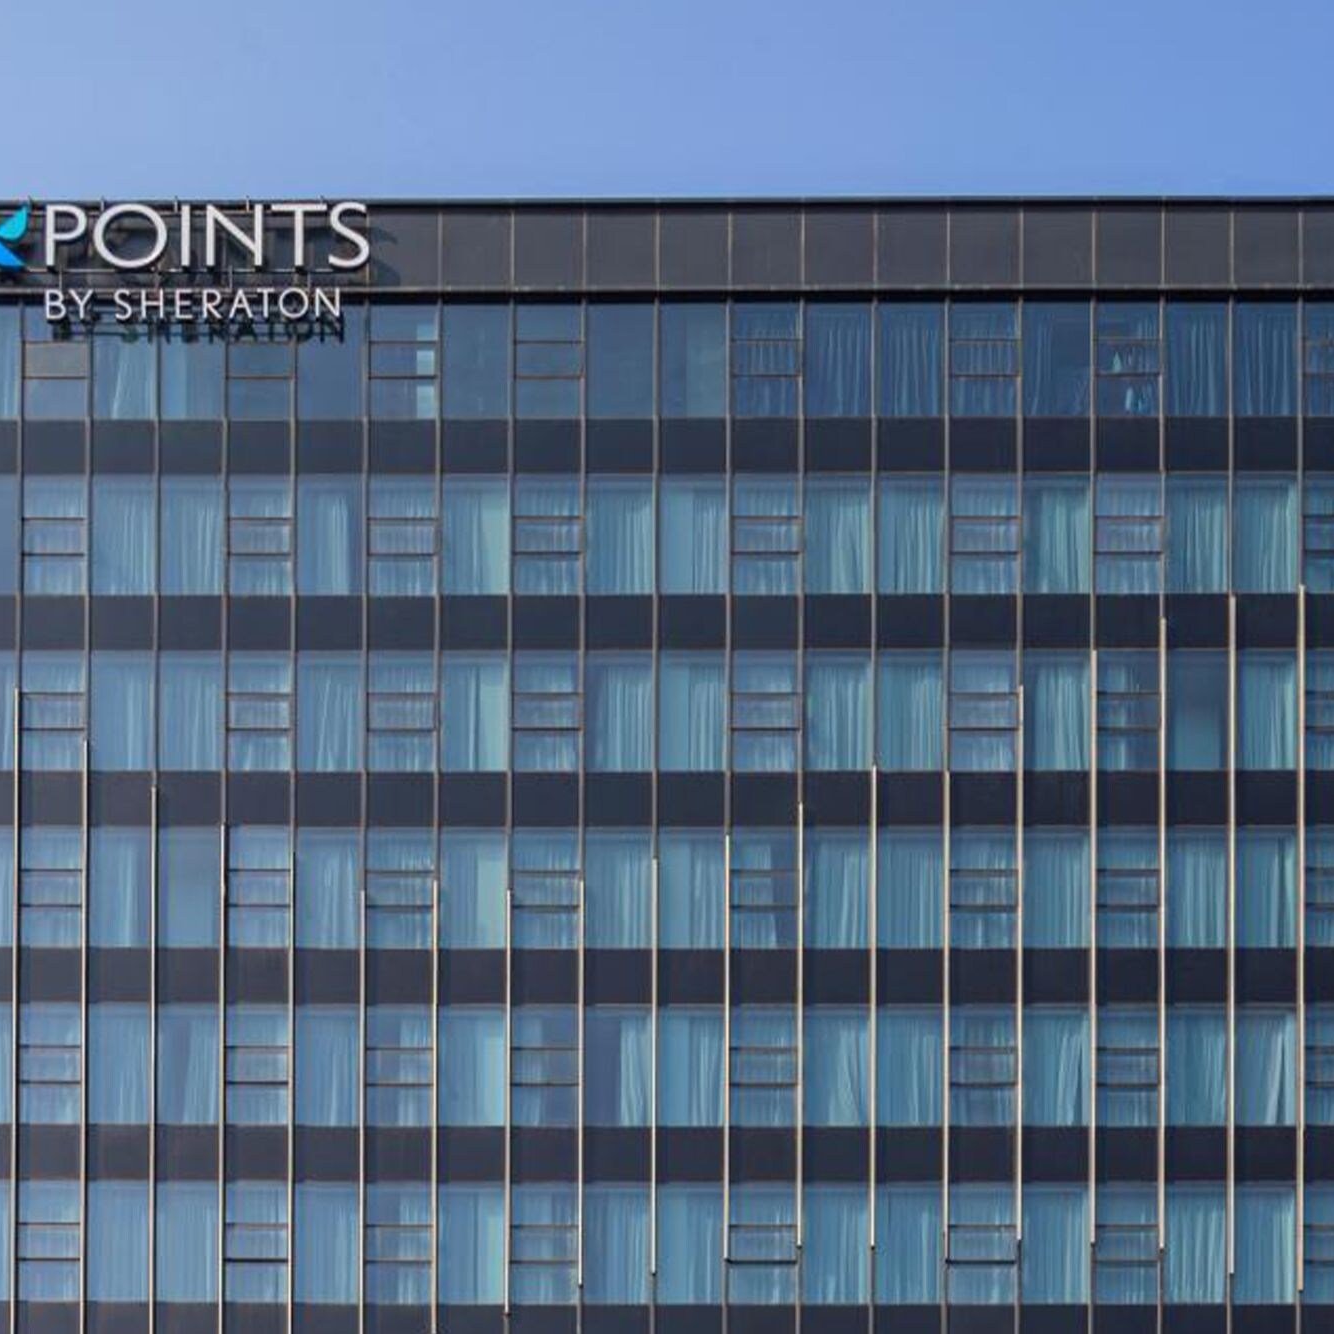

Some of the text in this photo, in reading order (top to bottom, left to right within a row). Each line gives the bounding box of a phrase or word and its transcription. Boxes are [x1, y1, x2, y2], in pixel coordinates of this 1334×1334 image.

[46, 202, 370, 268] POINTS
[46, 288, 341, 320] BY SHERATON
